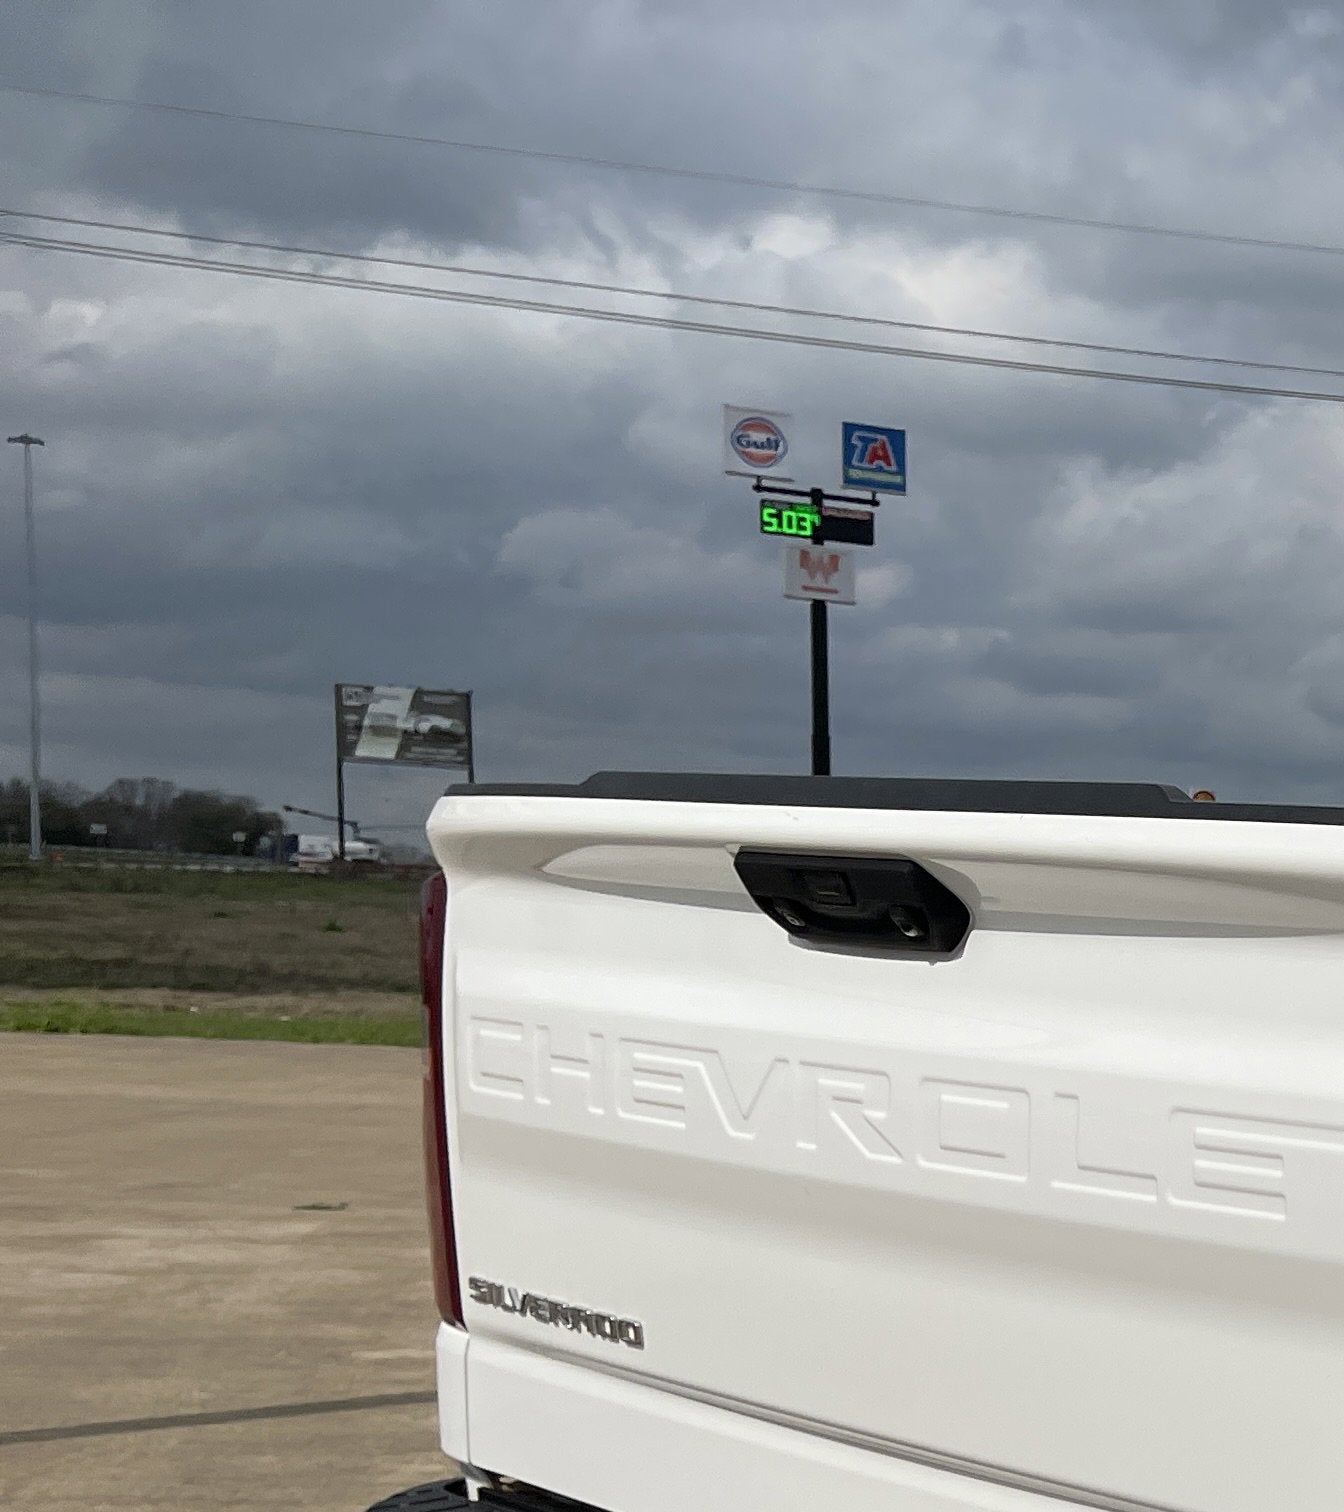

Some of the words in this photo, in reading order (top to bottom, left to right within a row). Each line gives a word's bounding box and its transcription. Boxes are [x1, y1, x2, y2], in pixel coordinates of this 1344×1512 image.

[736, 433, 782, 452] Gulf
[851, 431, 895, 470] TA
[469, 1276, 645, 1351] SILVERADO
